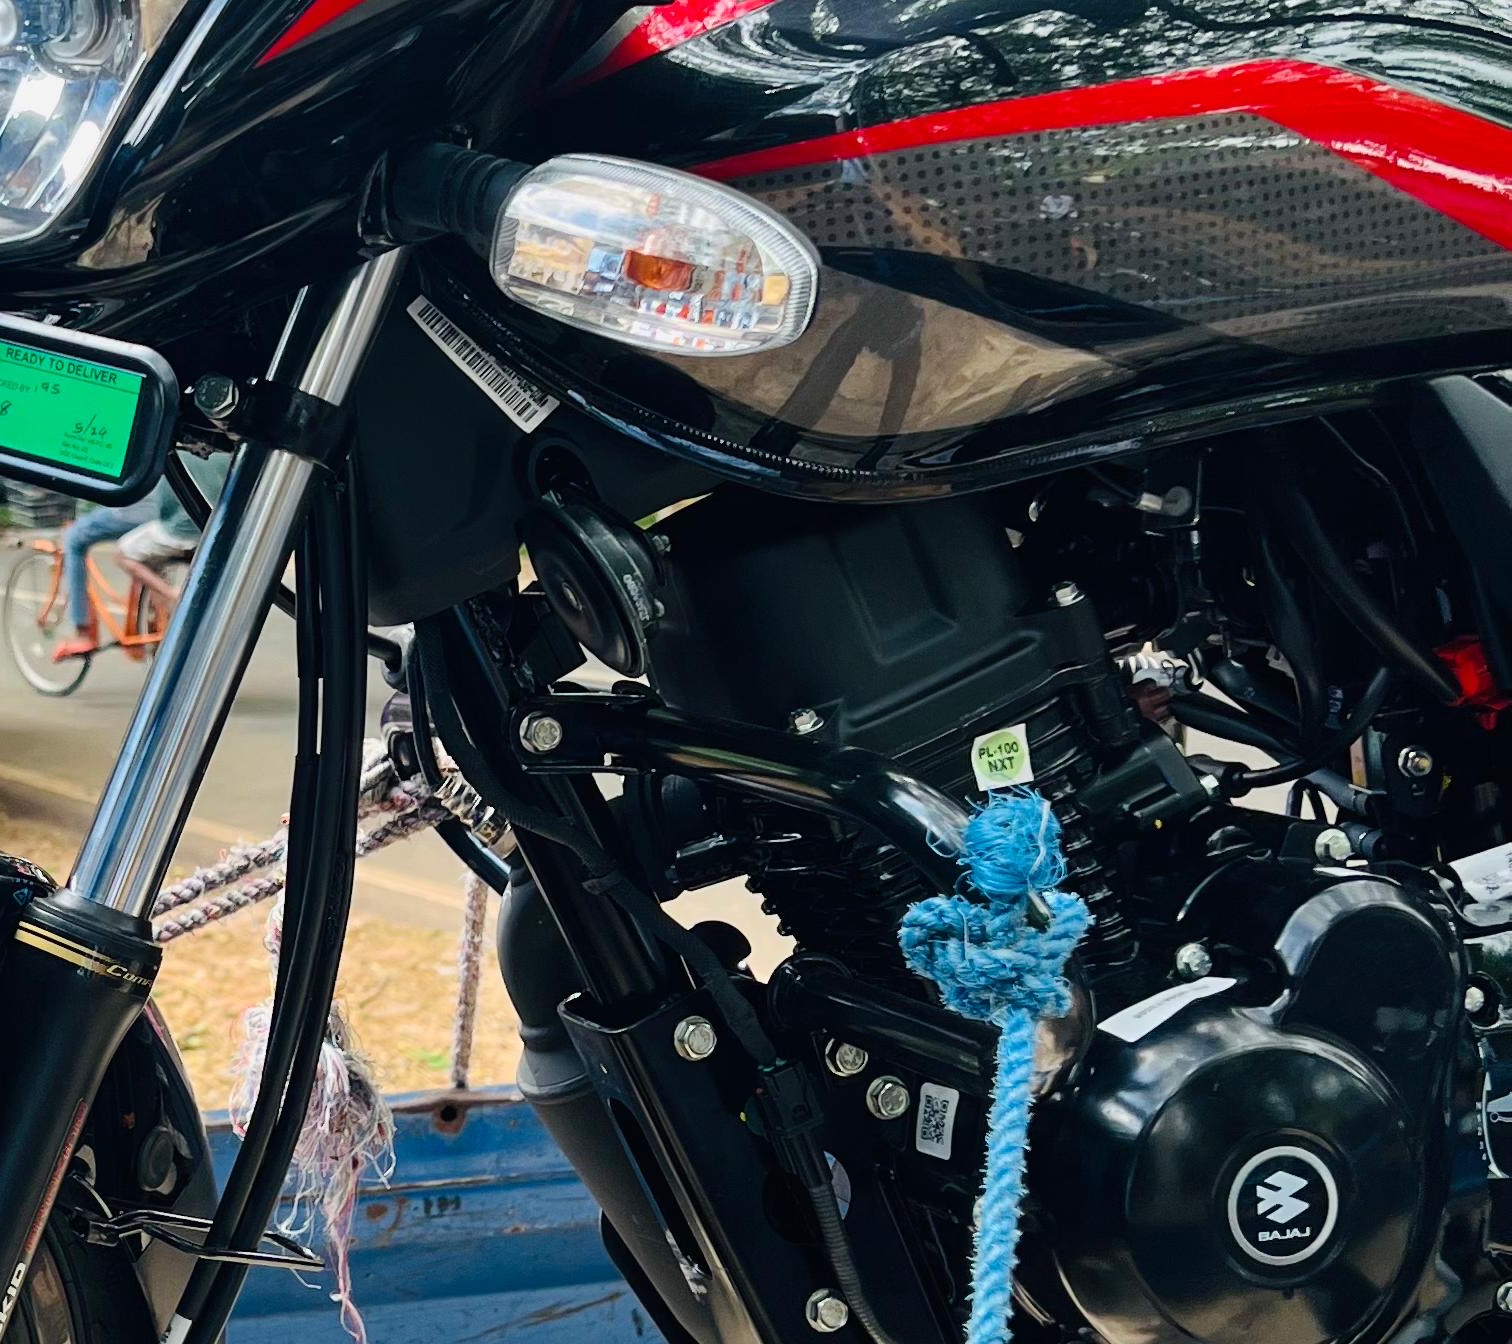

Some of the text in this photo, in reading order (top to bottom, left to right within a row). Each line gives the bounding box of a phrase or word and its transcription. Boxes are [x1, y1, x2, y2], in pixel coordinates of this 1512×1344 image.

[6, 347, 118, 385] READY TO DELIVER
[978, 741, 1019, 760] PL-100
[988, 756, 1015, 773] NXT
[1258, 1226, 1311, 1242] BAJAJ
